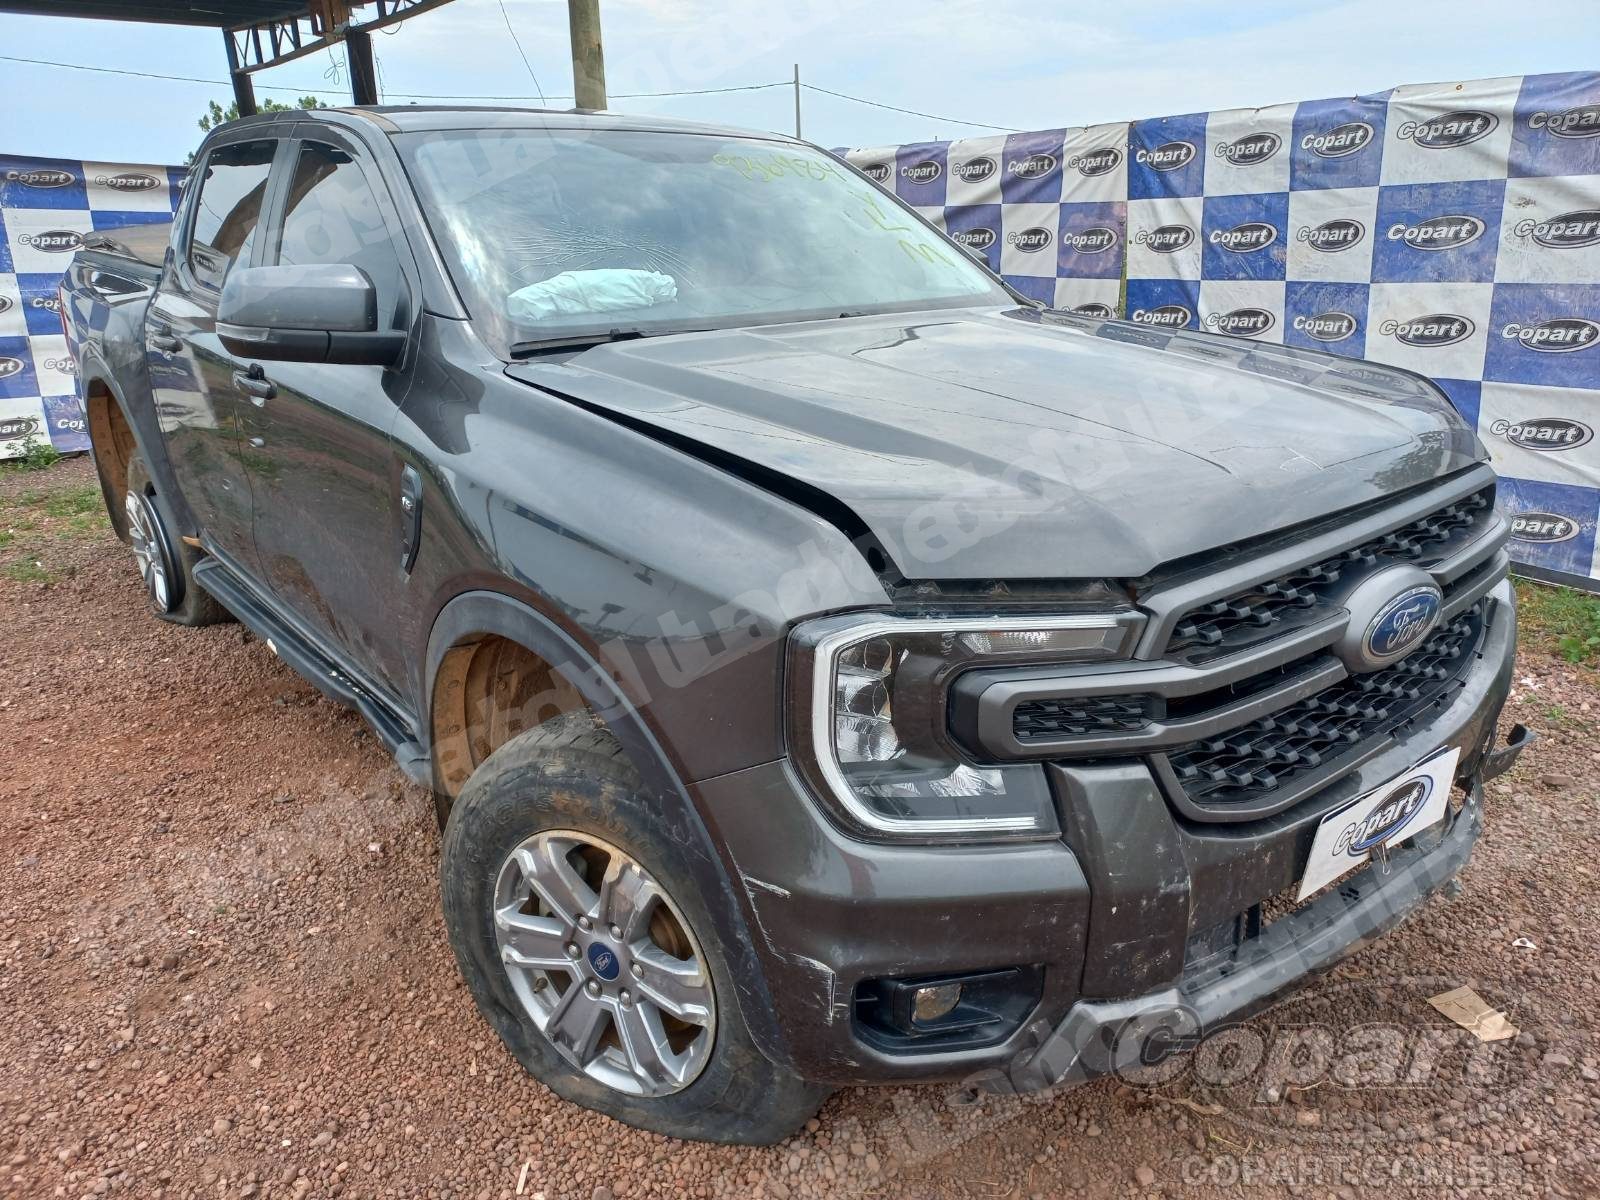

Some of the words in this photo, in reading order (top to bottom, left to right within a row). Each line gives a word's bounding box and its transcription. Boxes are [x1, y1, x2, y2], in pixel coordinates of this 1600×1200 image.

[1397, 114, 1485, 141] Copart
[1527, 109, 1600, 132] Copa
[1300, 124, 1366, 150] Copart
[1136, 146, 1188, 166] Copart
[1214, 136, 1275, 160] Copart
[901, 165, 936, 178] Copart
[952, 163, 991, 180] Copart
[1007, 157, 1050, 175] Copart
[1068, 152, 1115, 172] Copart
[6, 171, 67, 183] Copart
[864, 167, 886, 177] part
[96, 176, 150, 188] Copart
[18, 233, 77, 247] Copart
[952, 231, 990, 244] Copart
[1007, 230, 1047, 246] Copart
[1063, 231, 1111, 248] Copart
[1135, 228, 1189, 246] Copart
[1210, 227, 1269, 246] Copart
[1297, 222, 1357, 244] Copart
[1386, 220, 1472, 243] Copart
[32, 297, 61, 310] Cop
[1132, 309, 1184, 325] Copart
[1205, 313, 1264, 333] Copart
[1293, 316, 1349, 336] Copart
[1379, 319, 1461, 338] Copart
[1501, 323, 1591, 343] Copart
[44, 358, 75, 371] Cop
[1490, 419, 1580, 443] Copart
[1511, 517, 1567, 533] part
[1386, 603, 1429, 650] Ford
[1332, 781, 1422, 856] Copart
